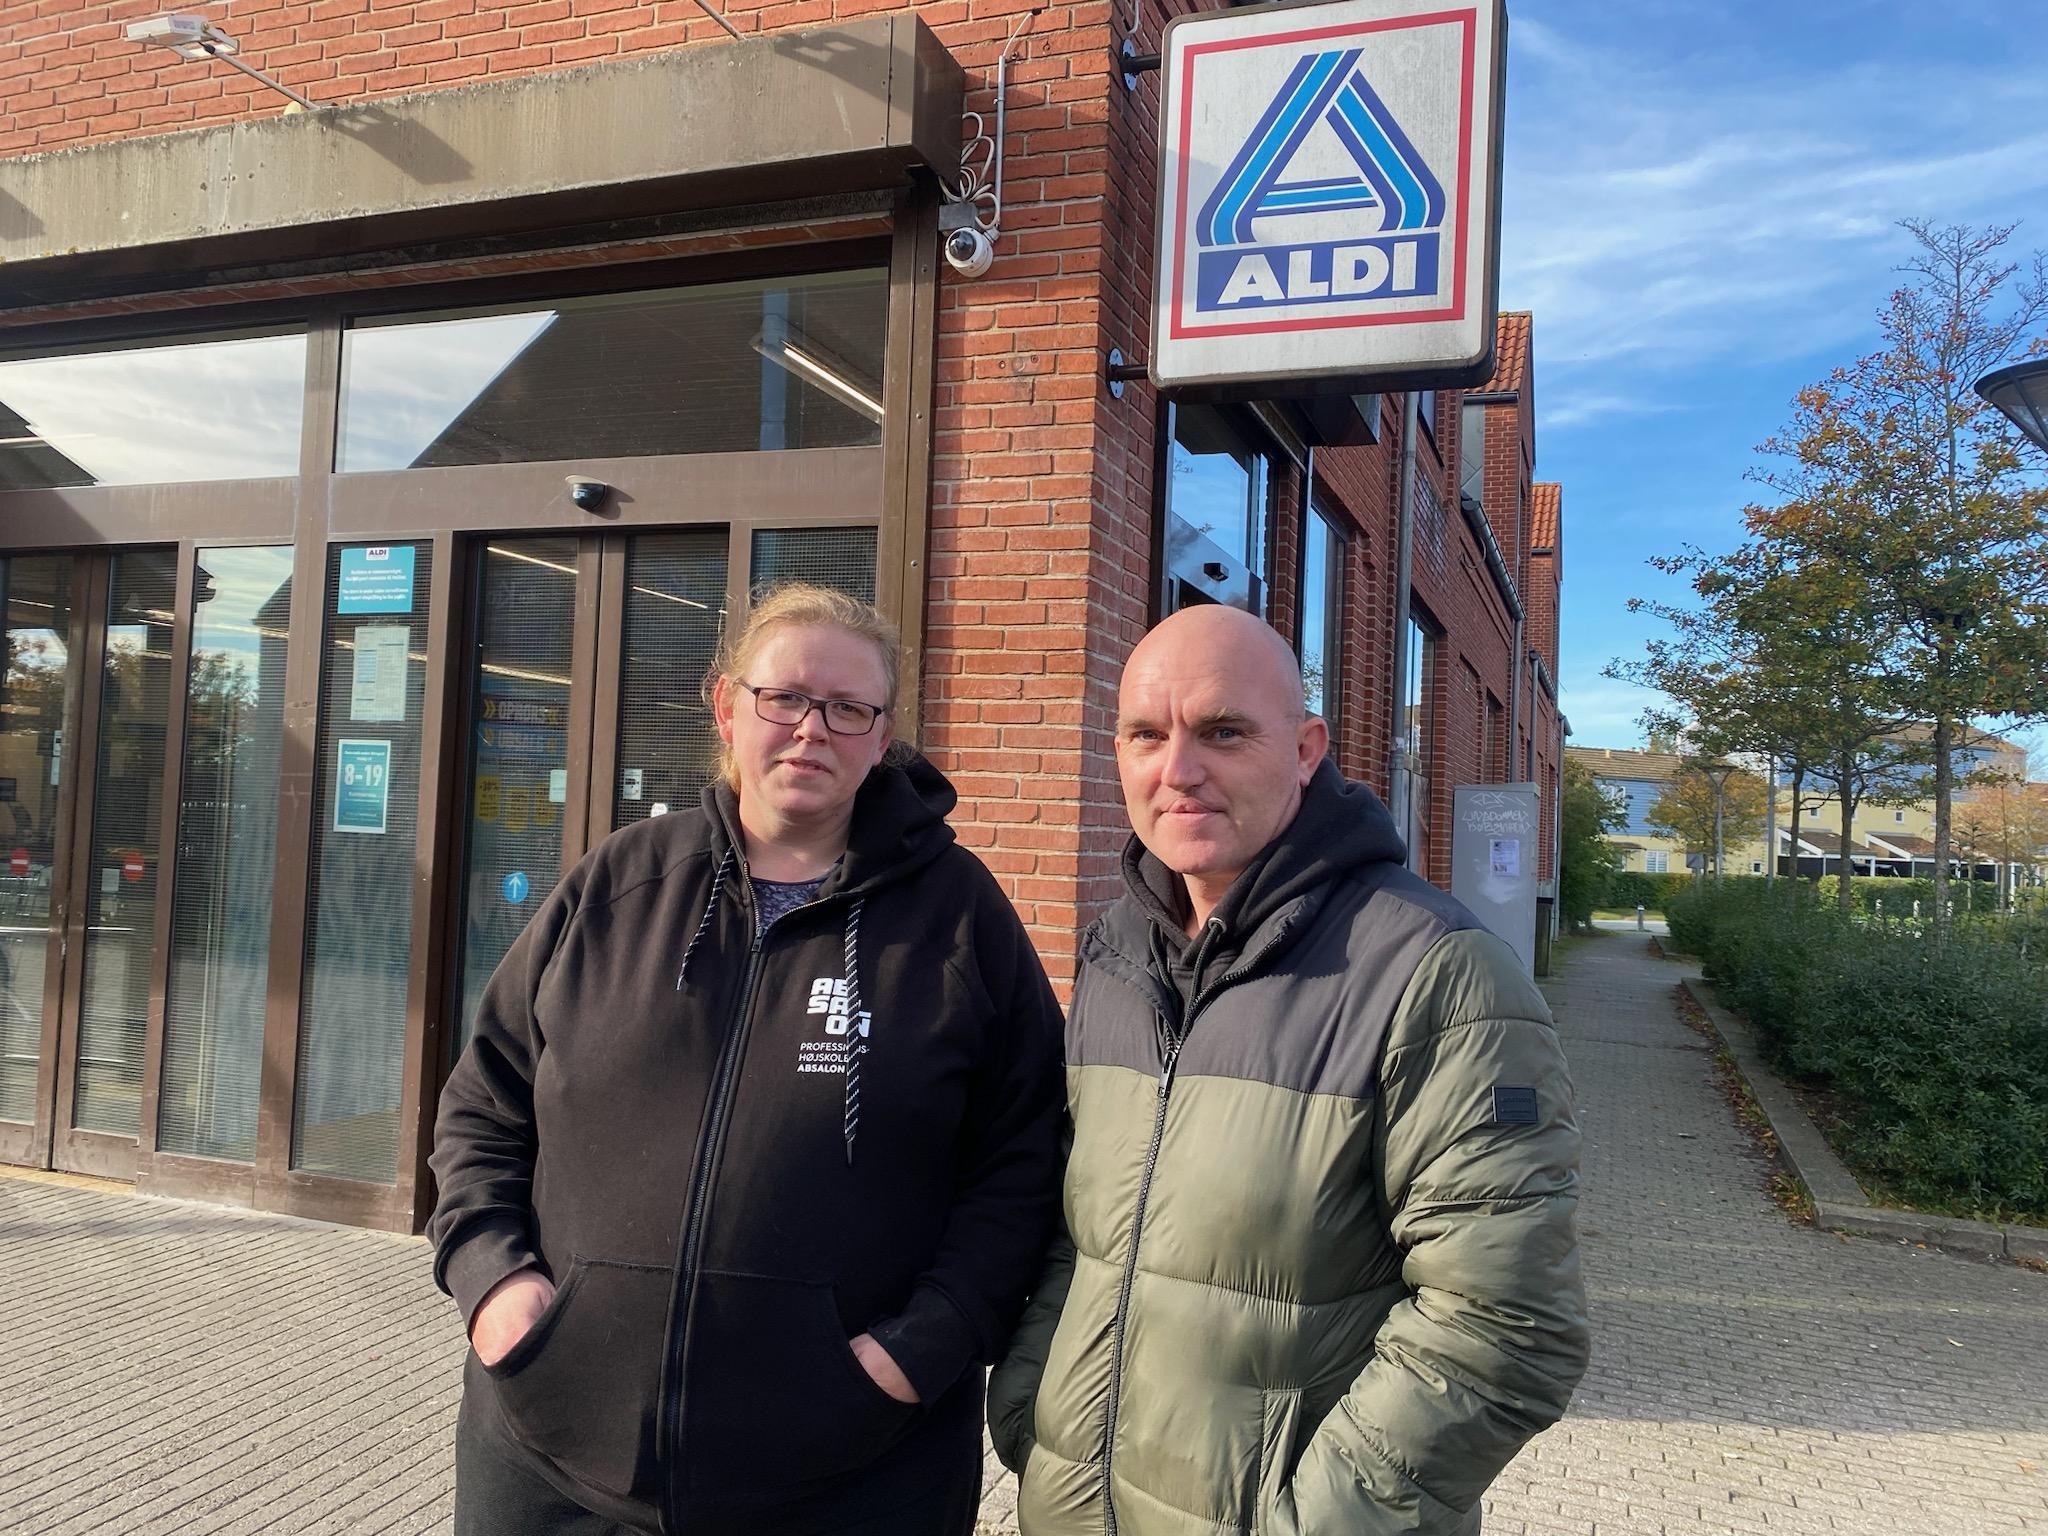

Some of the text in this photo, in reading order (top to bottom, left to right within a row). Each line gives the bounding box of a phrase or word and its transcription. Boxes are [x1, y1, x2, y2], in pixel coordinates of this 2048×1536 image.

[1216, 241, 1418, 305] ALDI
[368, 548, 387, 556] ALDI
[798, 1053, 850, 1063] HØJSKOLE
[797, 1063, 845, 1074] ABSALON
